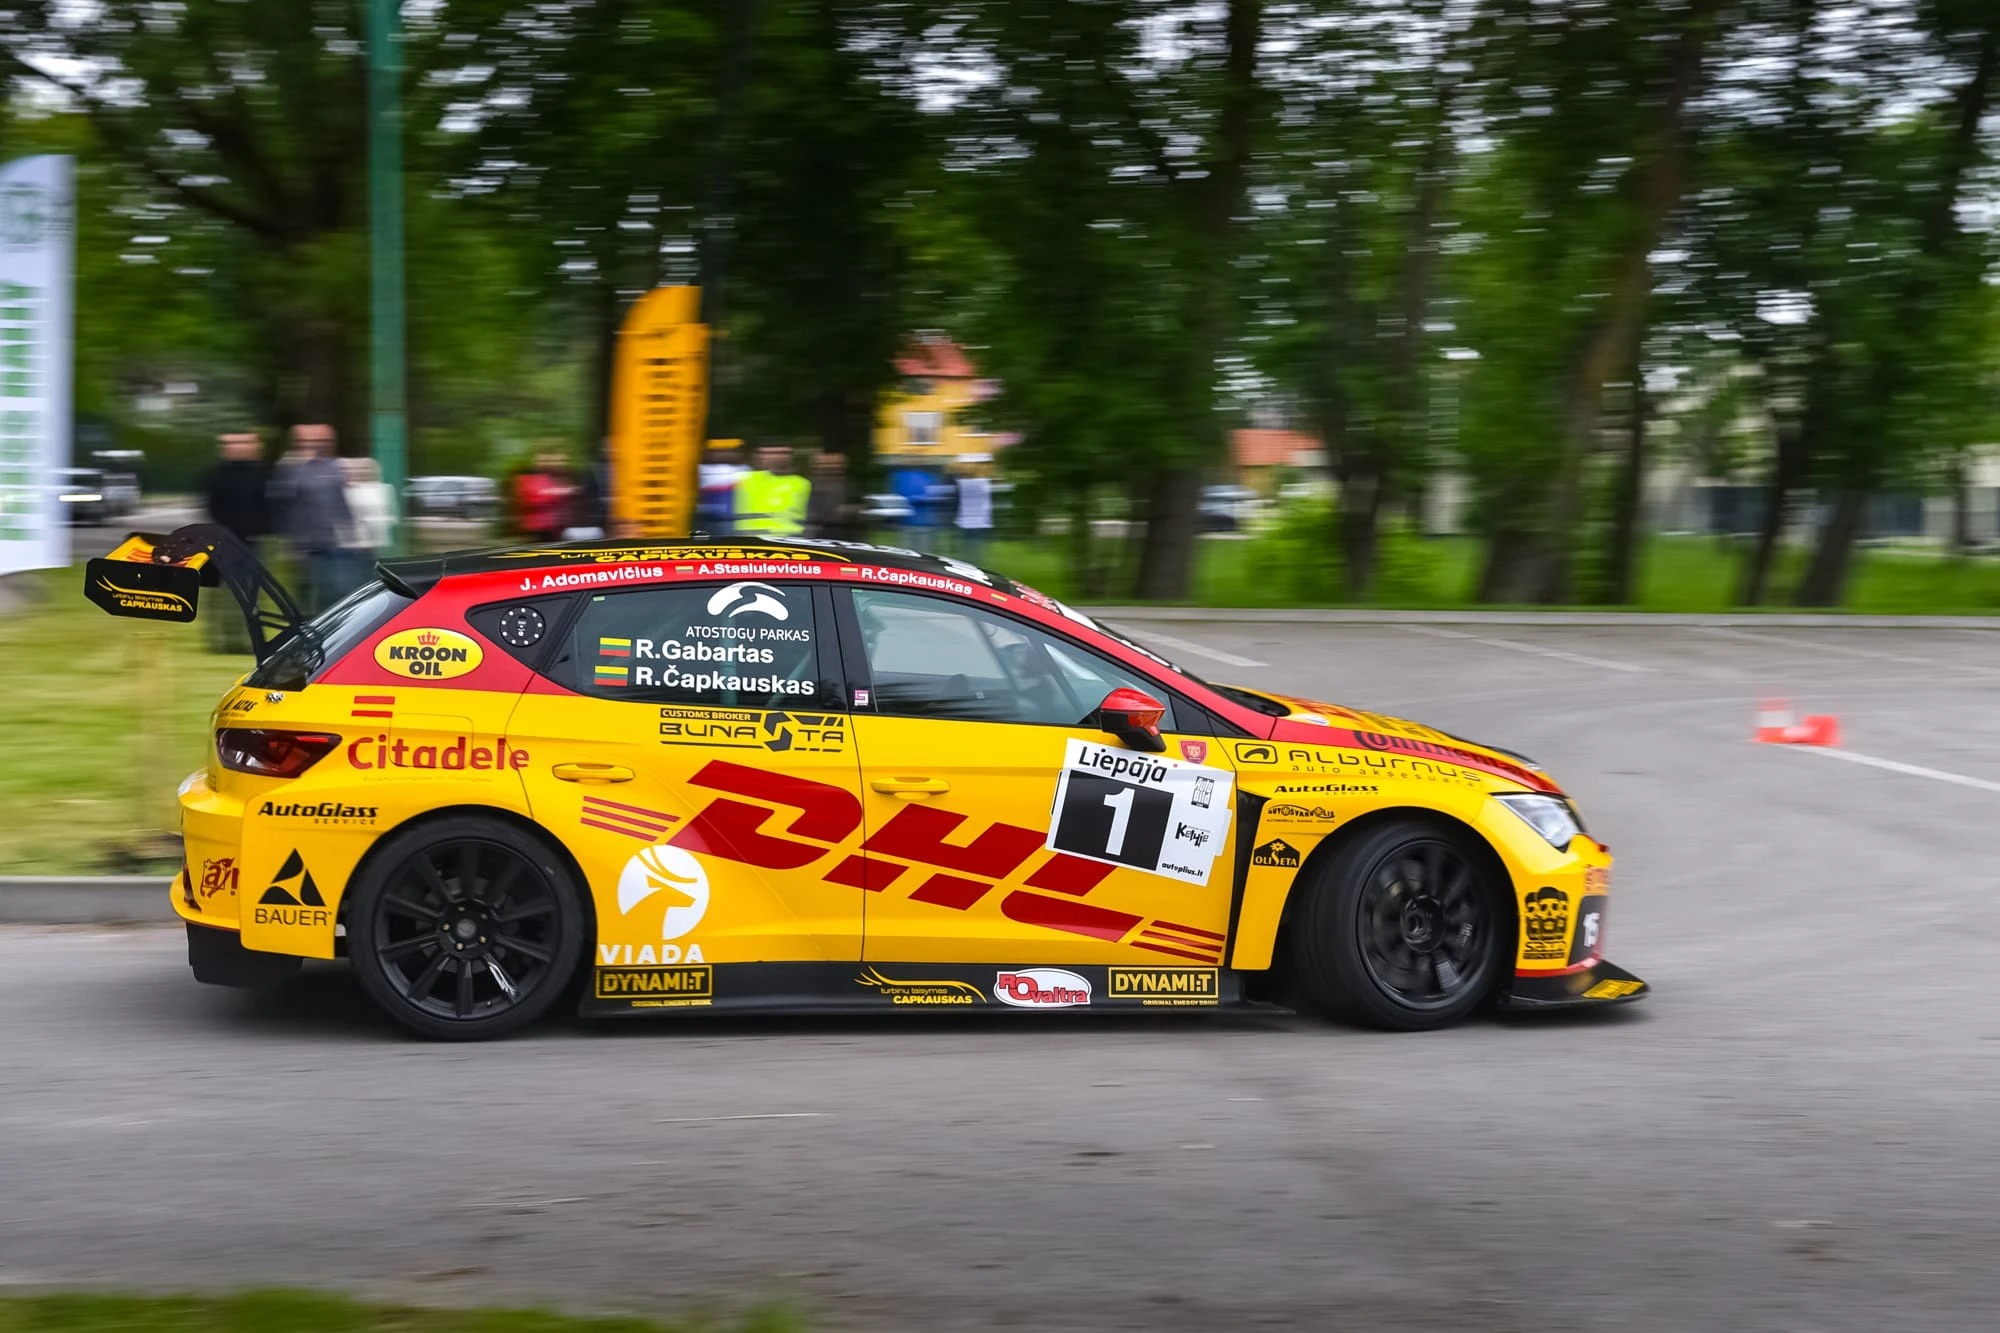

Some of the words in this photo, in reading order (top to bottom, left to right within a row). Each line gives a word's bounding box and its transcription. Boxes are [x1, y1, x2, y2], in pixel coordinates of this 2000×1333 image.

[595, 552, 811, 563] CAPKAUSKAS
[698, 563, 822, 575] A.Stasiulevicius
[520, 577, 537, 591] J.
[542, 566, 664, 588] Adomavičius
[861, 568, 973, 595] R.Čapkauskas
[120, 599, 182, 612] CAPKAUSKAS
[685, 625, 755, 642] ATOSTOGŲ
[760, 628, 810, 642] PARKAS
[389, 645, 467, 663] KROON
[636, 638, 774, 664] R.Gabartas
[408, 660, 443, 676] OIL
[635, 664, 815, 696] R.Čapkauskas
[662, 709, 710, 719] CUSTOMS
[711, 711, 751, 721] BROKER
[347, 734, 530, 770] Citadele
[1078, 746, 1168, 785] Liepāja
[1292, 764, 1341, 774] auto
[1274, 784, 1379, 793] AutoGlass
[258, 801, 380, 818] AutoGlass
[314, 818, 376, 826] SERVICE
[1103, 787, 1136, 857] 1
[664, 759, 1144, 942] DHL
[1161, 862, 1204, 877] autoplius.lt
[255, 908, 328, 926] BAUER
[599, 944, 705, 965] VIADA
[893, 995, 973, 1004] CAPKAUSKAS
